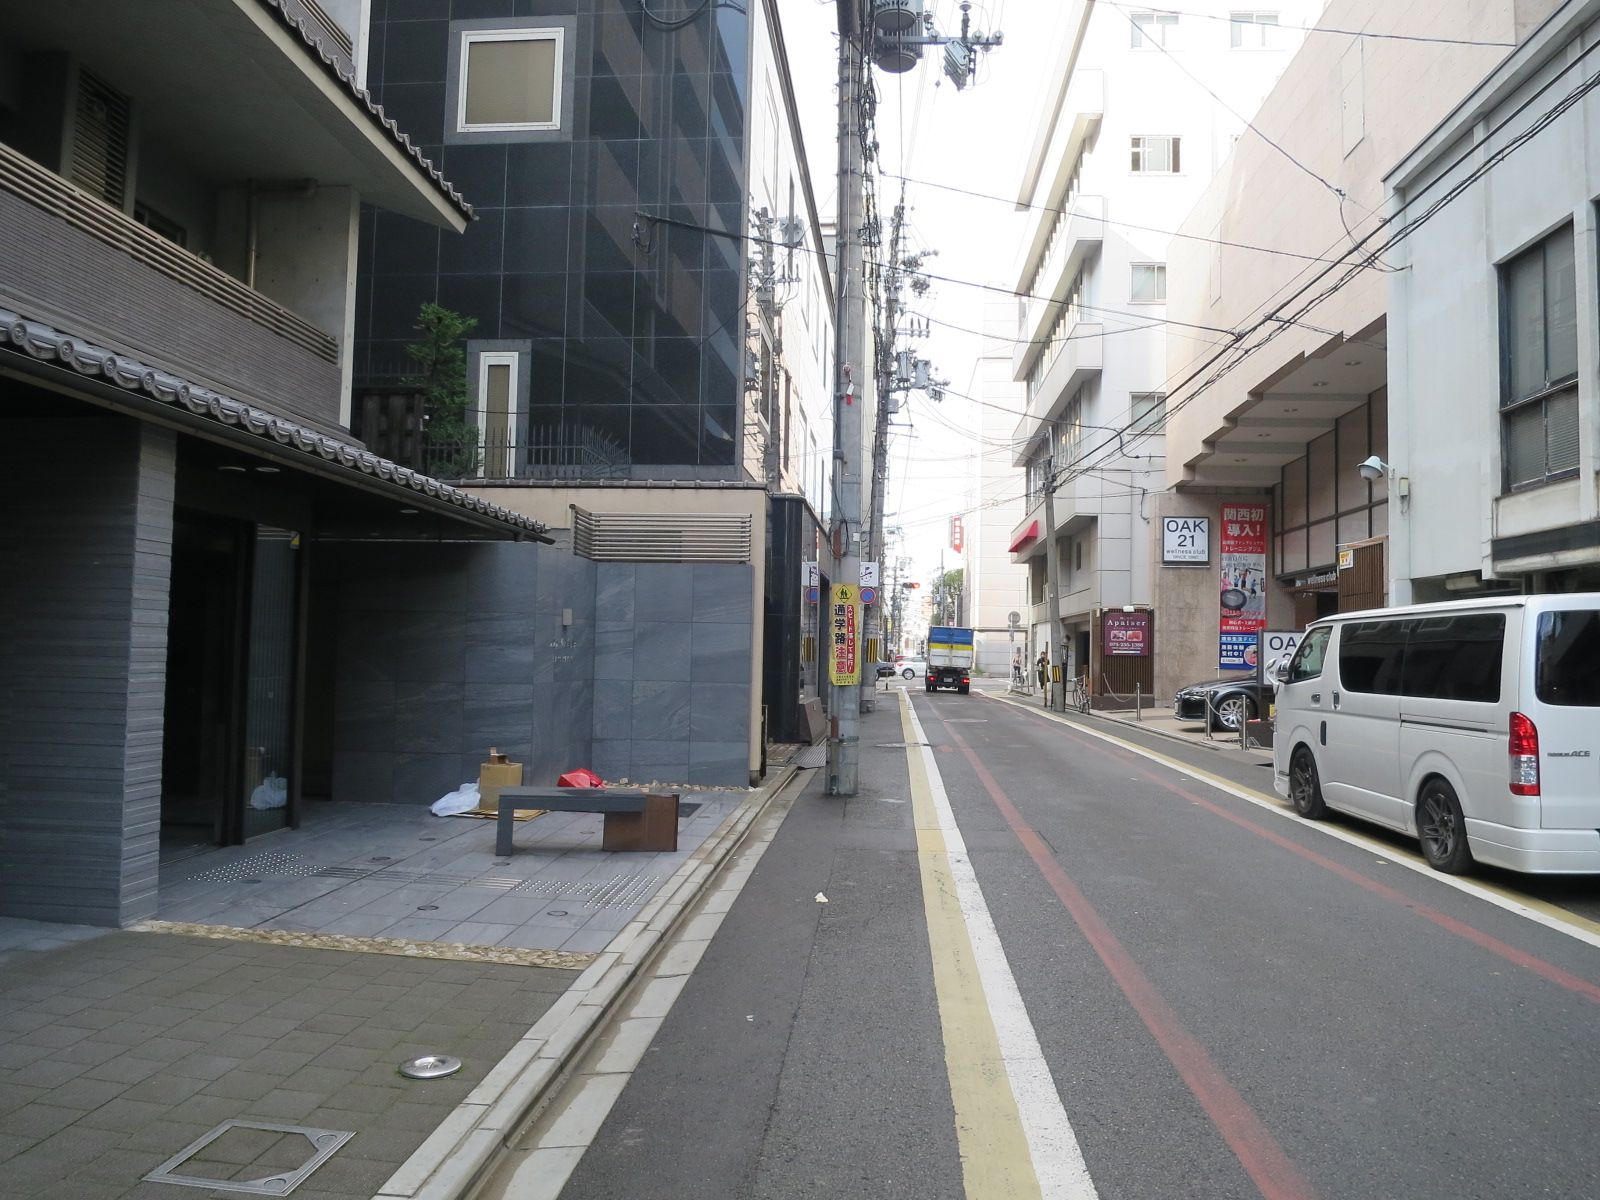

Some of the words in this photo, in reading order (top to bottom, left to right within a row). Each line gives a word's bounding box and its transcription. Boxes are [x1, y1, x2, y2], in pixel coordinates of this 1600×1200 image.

[1224, 507, 1264, 522] 関西初
[1166, 519, 1206, 533] OAK
[1177, 534, 1195, 547] 21
[834, 604, 847, 675] 通学路注意
[1269, 636, 1300, 651] OA
